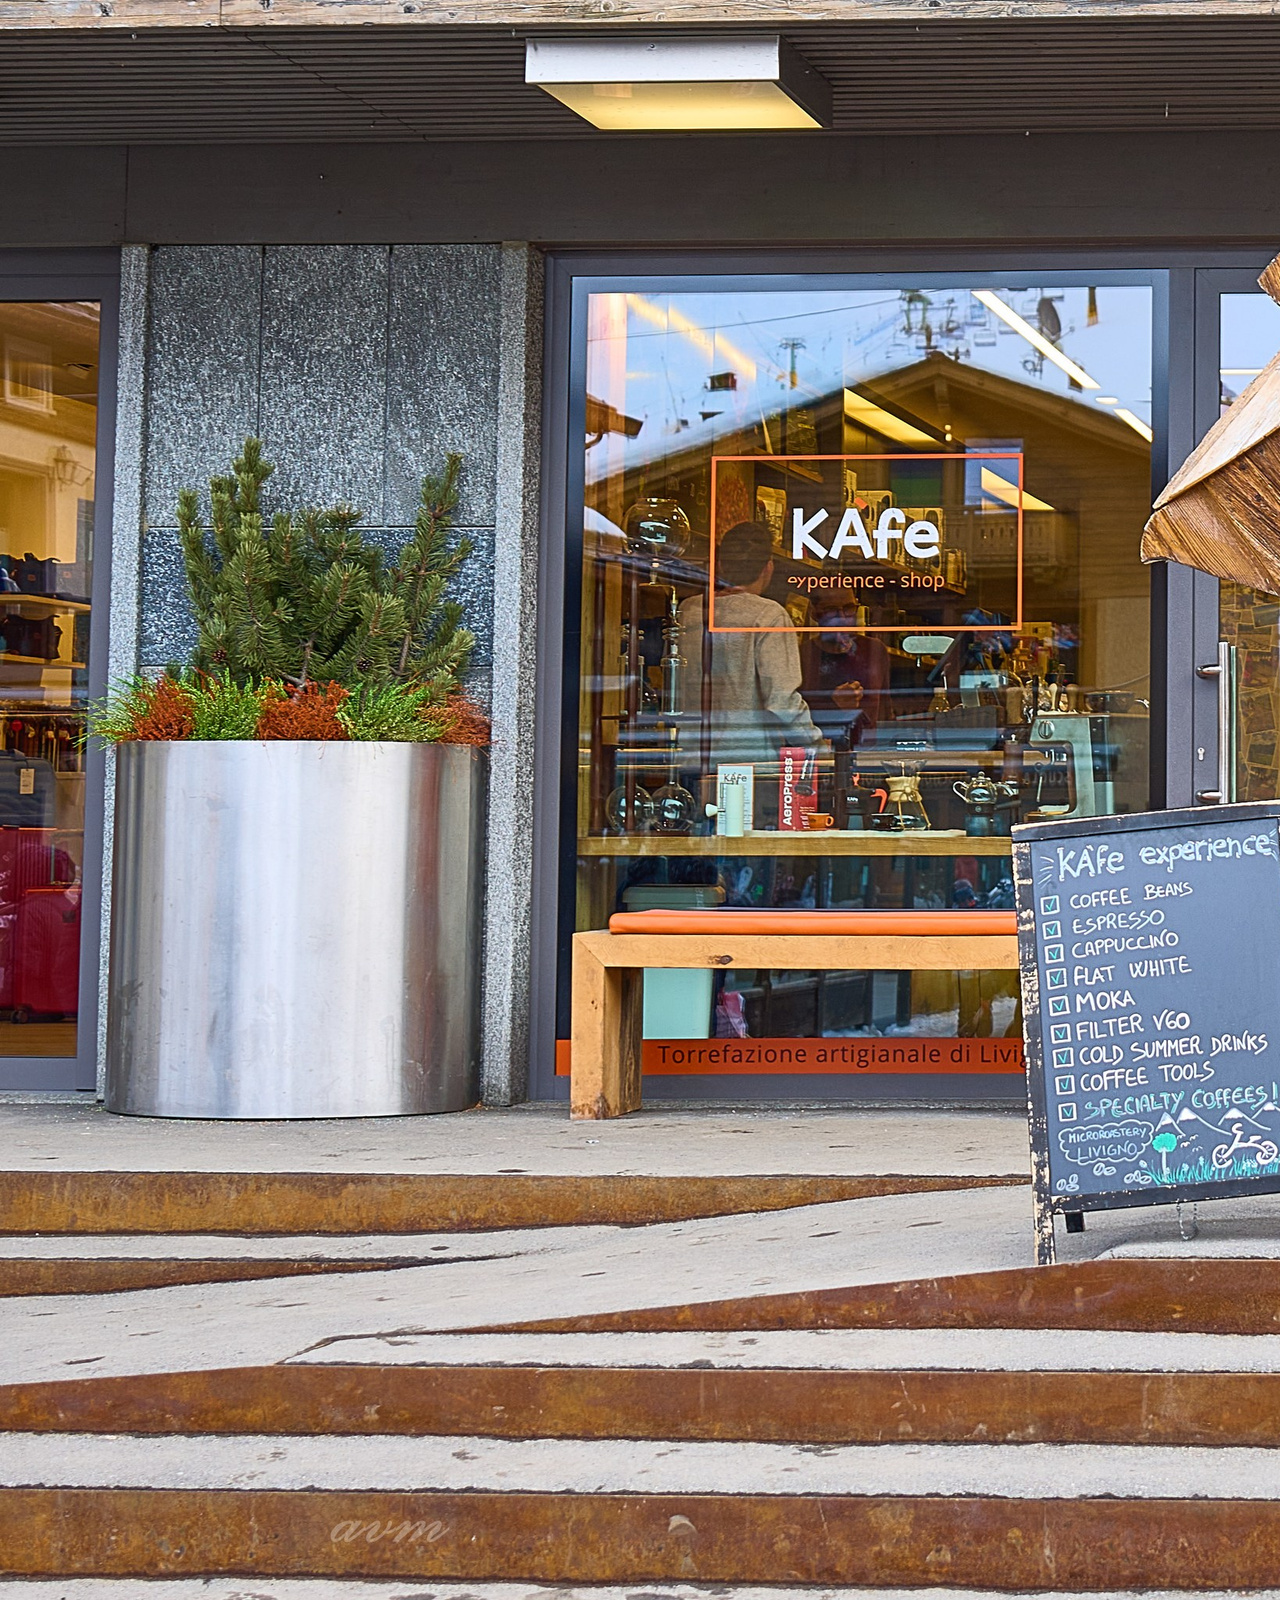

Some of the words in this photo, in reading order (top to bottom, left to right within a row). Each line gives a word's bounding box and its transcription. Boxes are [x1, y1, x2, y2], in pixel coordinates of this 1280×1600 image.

[900, 572, 945, 592] shop
[1139, 834, 1272, 873] experience
[1069, 887, 1132, 910] COFFEE
[1143, 881, 1193, 901] BEANS
[1072, 909, 1165, 935] ESPRESSO
[1071, 929, 1179, 959] CAPPUCCINO
[1073, 965, 1115, 987] FLAT
[1129, 955, 1192, 979] WHITE
[1075, 990, 1136, 1013] MOKA
[1076, 1013, 1144, 1041] FILTER
[1152, 1009, 1191, 1031] V60
[657, 1044, 807, 1064] Torrefazione
[815, 1043, 939, 1068] artigianale
[950, 1043, 973, 1064] di
[1078, 1046, 1124, 1066] COLD
[1131, 1035, 1203, 1063] SUMMER
[1209, 1030, 1268, 1057] DRINKS
[1080, 1067, 1149, 1092] COFFEE
[1158, 1061, 1215, 1083] TOOLS
[1083, 1090, 1185, 1121] SPECIALTY
[1068, 1127, 1147, 1144] MICROROASTERY
[1077, 1140, 1138, 1164] LIVIGNO
